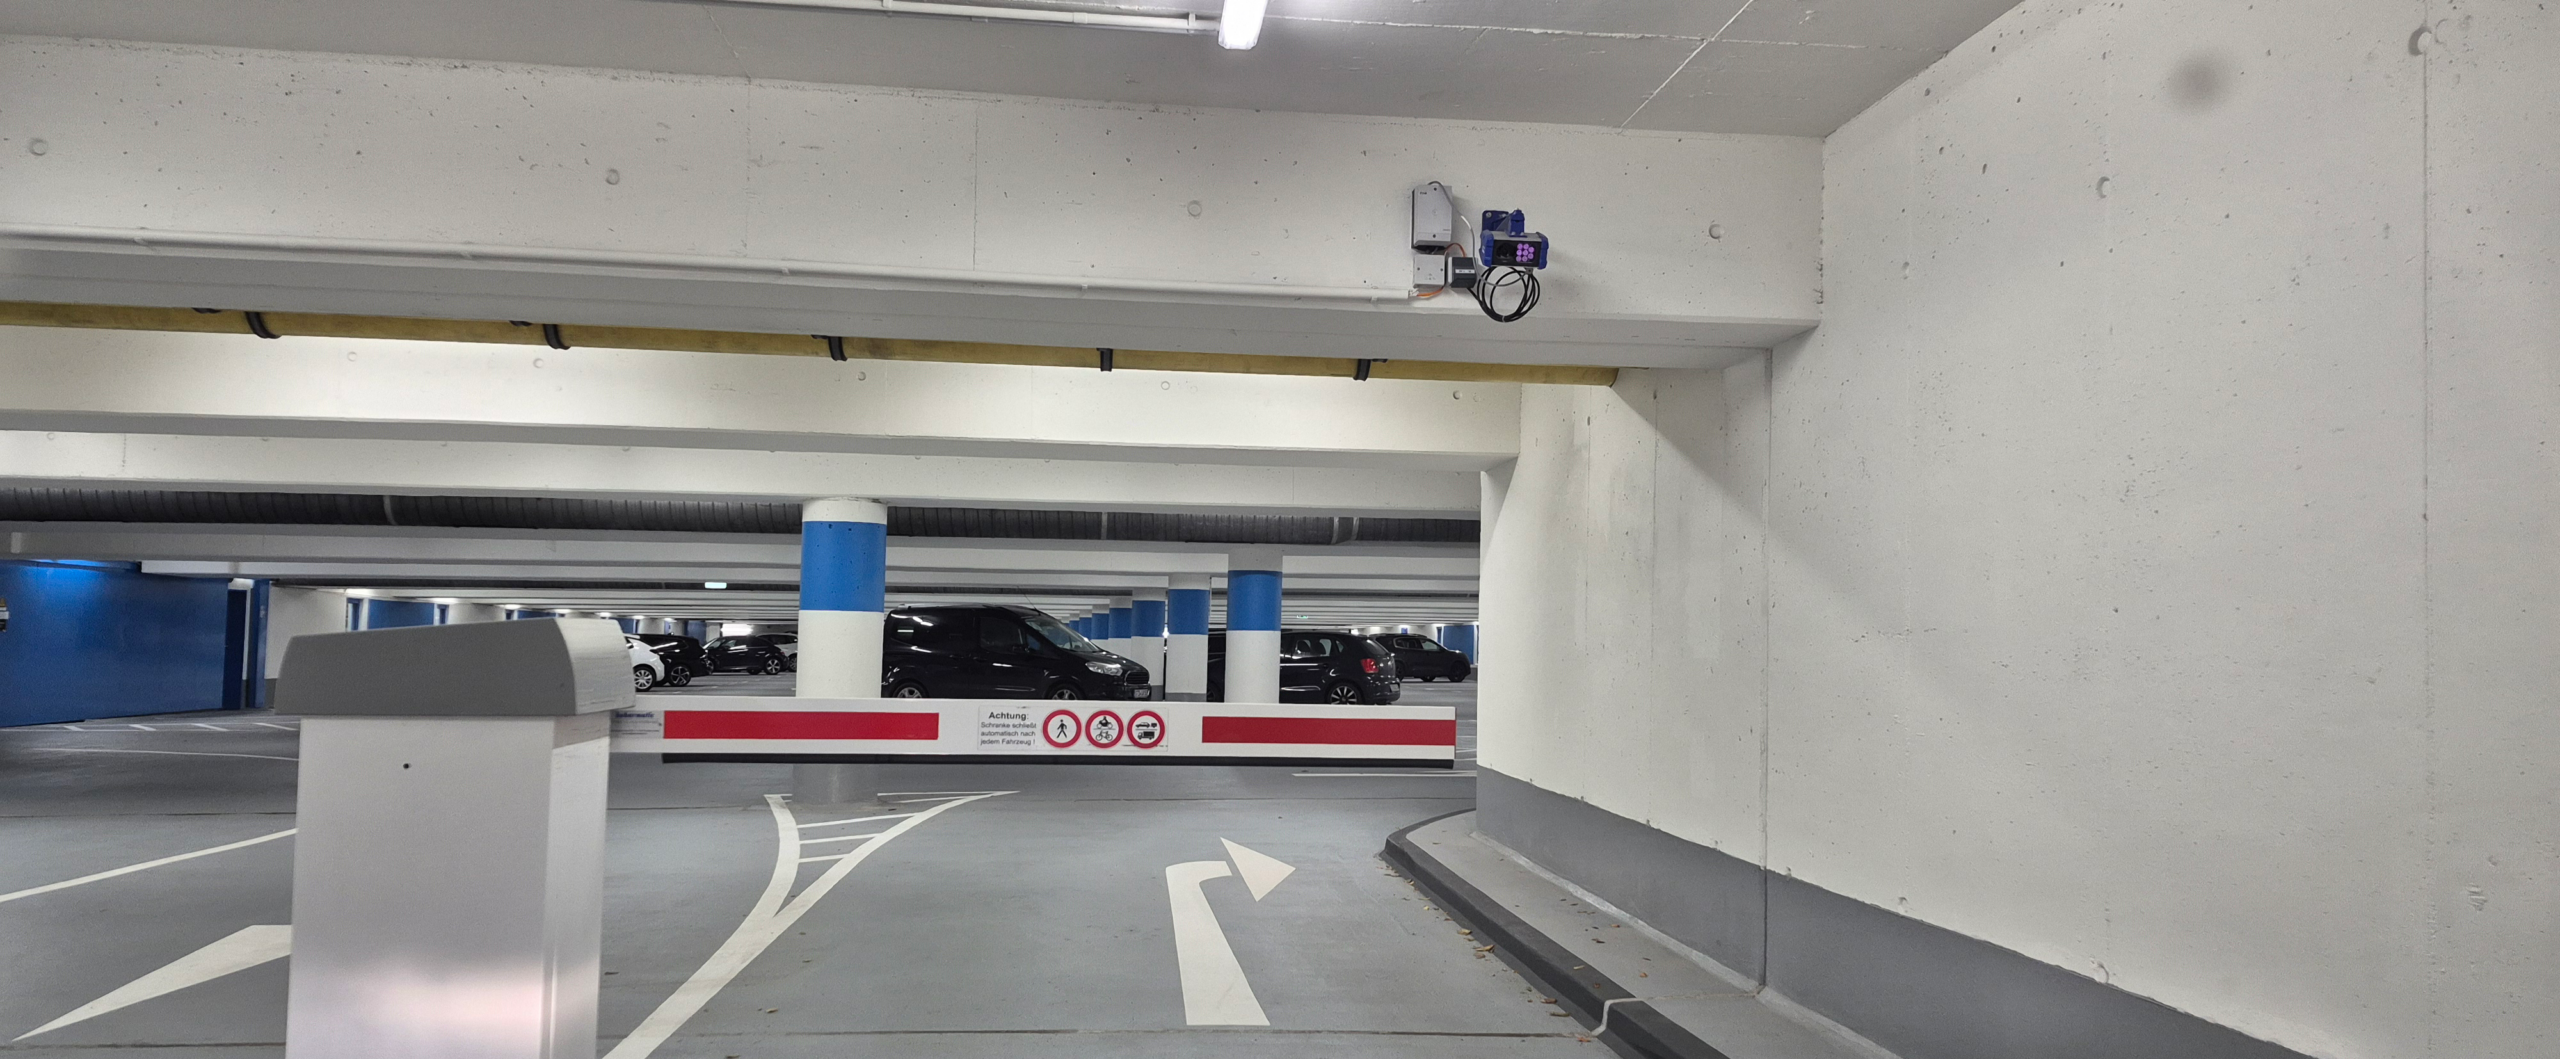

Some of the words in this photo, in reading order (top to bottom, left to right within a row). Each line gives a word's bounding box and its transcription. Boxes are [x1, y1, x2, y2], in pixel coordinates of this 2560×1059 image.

[989, 711, 1029, 721] Achtung:
[980, 738, 1001, 746] jedem
[1001, 738, 1032, 746] Fahrzeug
